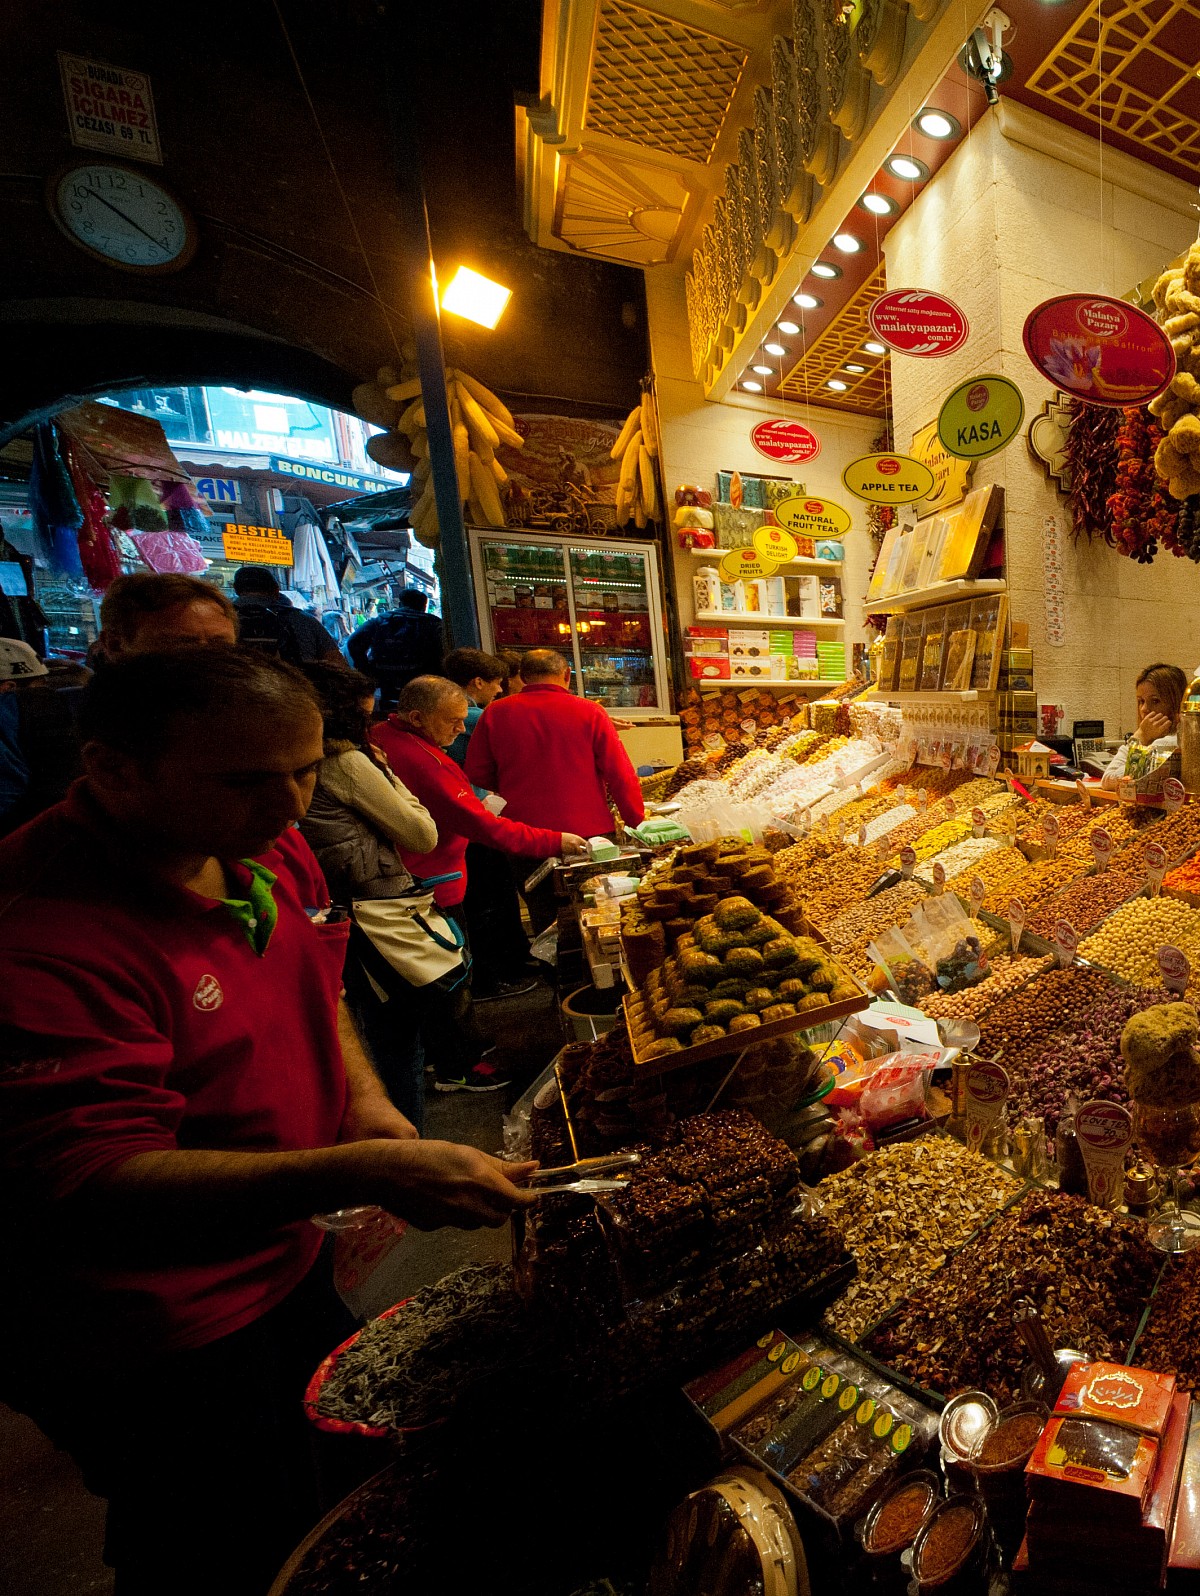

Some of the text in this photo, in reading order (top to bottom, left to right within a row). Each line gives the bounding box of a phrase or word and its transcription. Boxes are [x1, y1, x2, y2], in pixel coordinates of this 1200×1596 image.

[138, 130, 152, 144] TL
[1083, 308, 1121, 323] Malatya
[927, 334, 953, 342] com.tr
[957, 419, 1002, 447] KASA
[277, 460, 361, 489] BONCUK
[861, 483, 919, 492] APPLE TEA
[793, 513, 835, 524] NATURAL
[225, 523, 287, 539] BESTEL
[787, 520, 840, 533] FRUIT TEAS
[766, 544, 788, 552] TURKISH
[766, 550, 788, 558] DELIGHT
[1083, 1116, 1130, 1129] LOVE TEA
